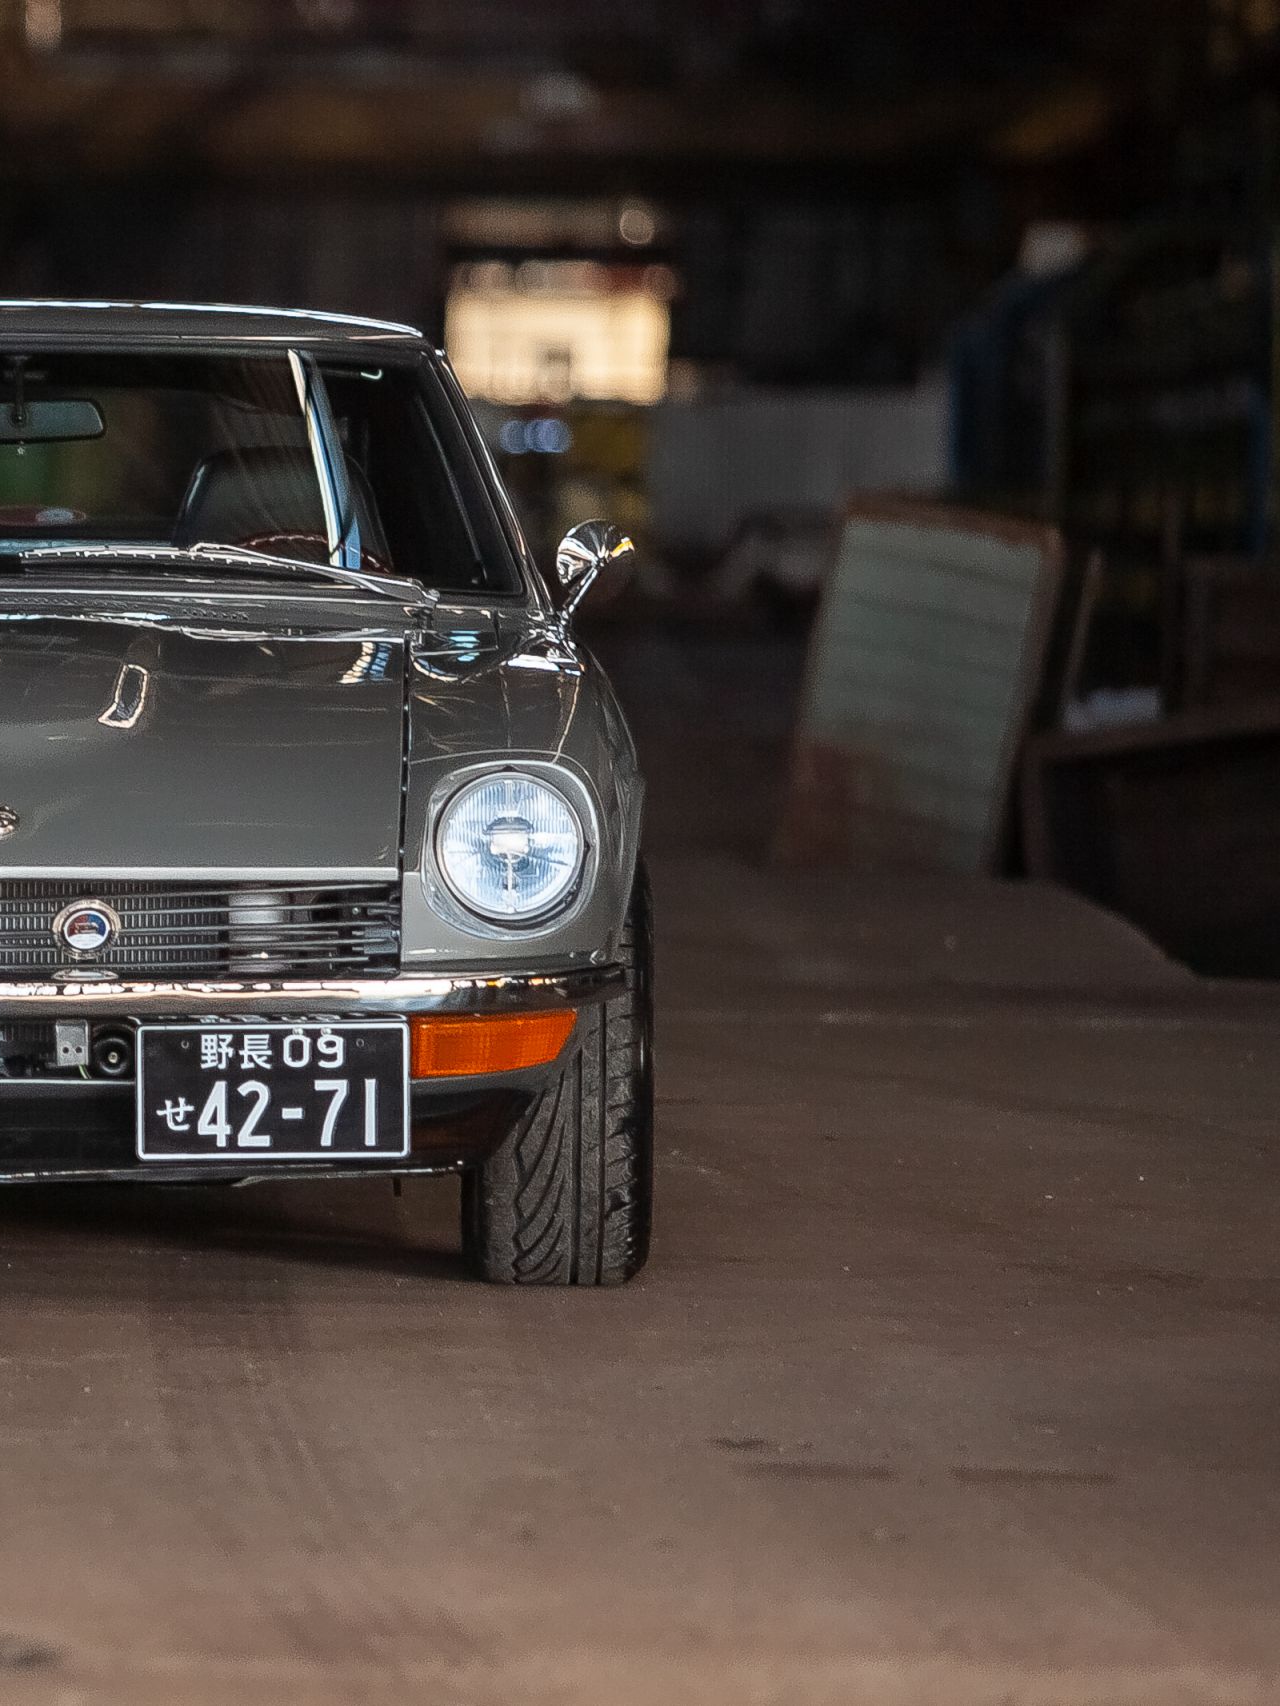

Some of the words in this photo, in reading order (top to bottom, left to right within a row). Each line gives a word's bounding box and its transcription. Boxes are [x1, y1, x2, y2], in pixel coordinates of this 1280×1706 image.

[200, 1034, 273, 1069] 野長
[283, 1033, 344, 1068] 09
[156, 1097, 194, 1131] せ
[197, 1078, 376, 1147] 42-71
